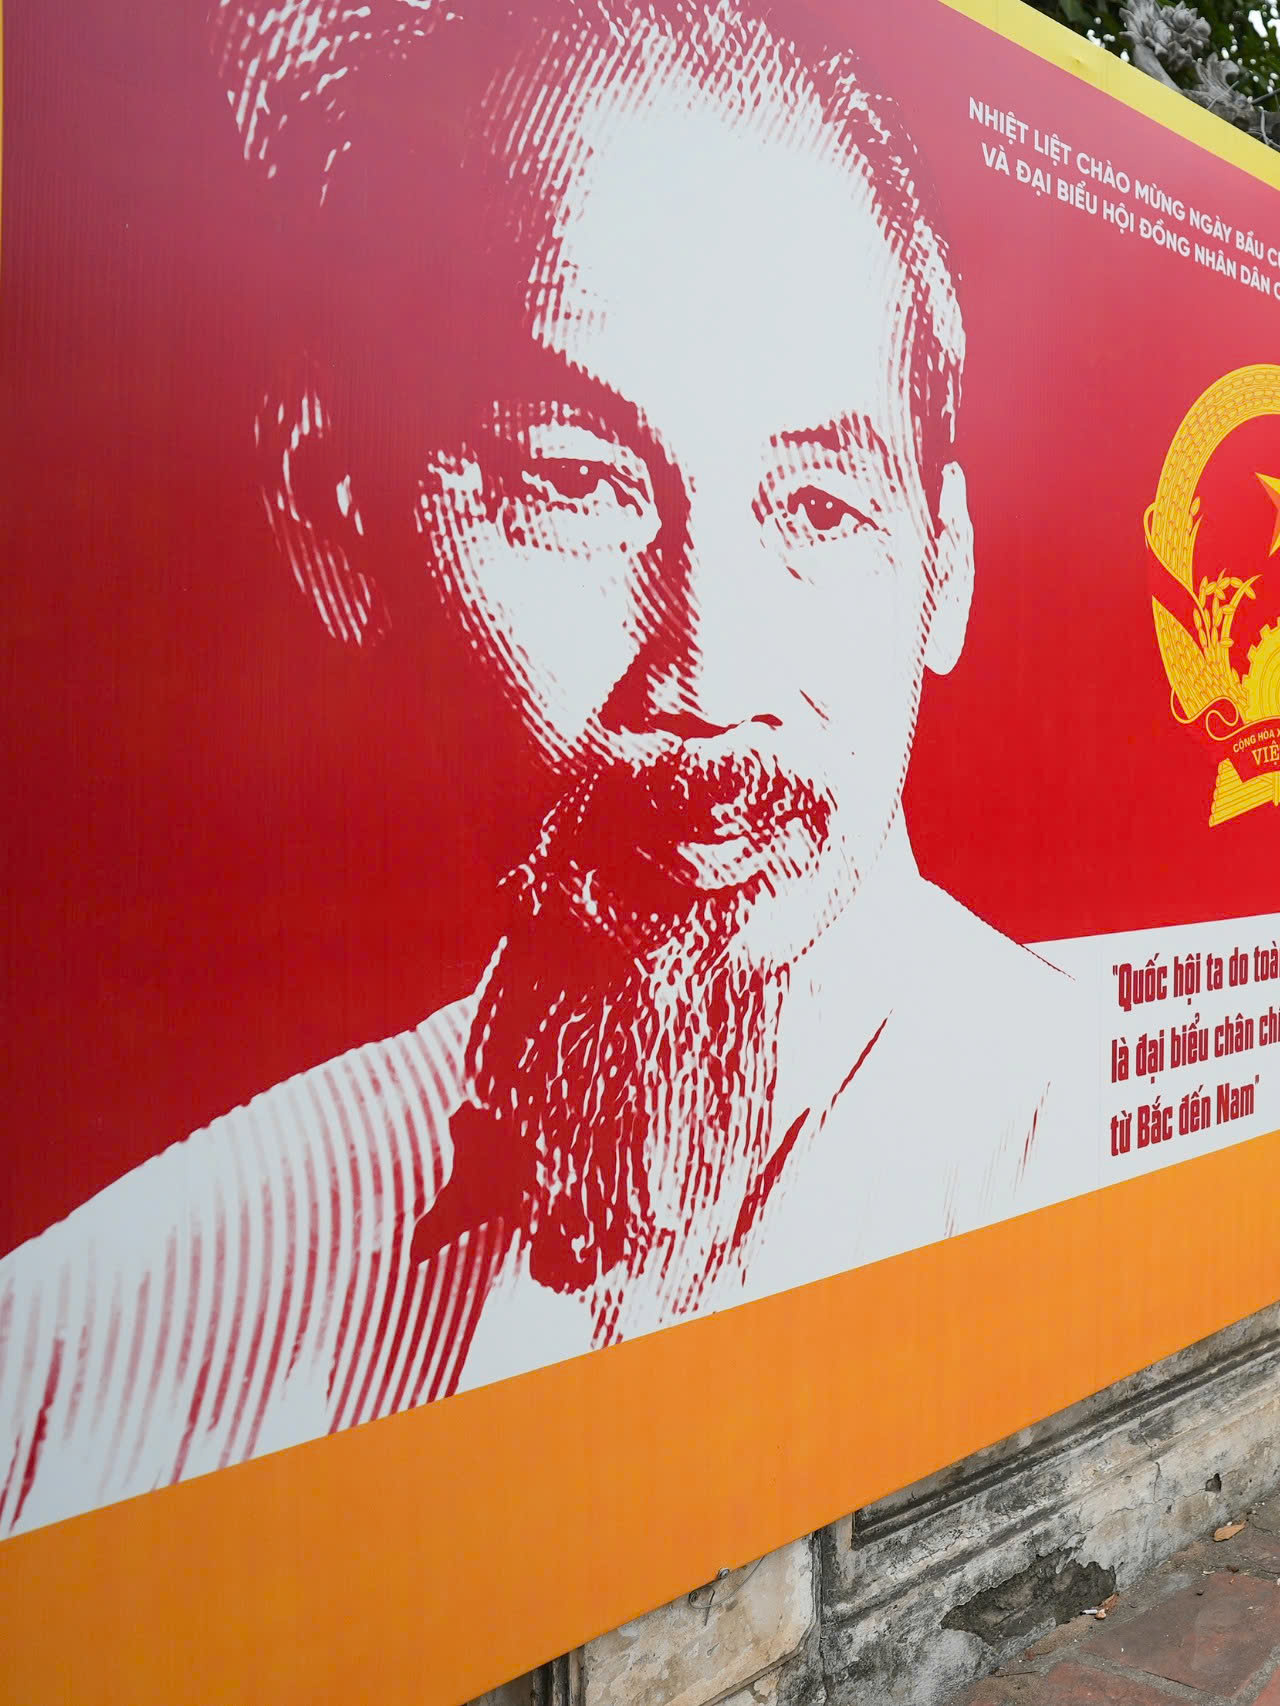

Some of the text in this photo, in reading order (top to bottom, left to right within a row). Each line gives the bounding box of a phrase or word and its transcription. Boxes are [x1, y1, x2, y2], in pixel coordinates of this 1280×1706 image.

[969, 96, 1029, 145] NHIỆT
[1034, 129, 1072, 167] LIỆT
[1076, 152, 1130, 194] CHÀO
[1135, 179, 1185, 221] MỪNG
[1190, 208, 1232, 244] NGÀY
[981, 142, 1010, 176] VÀ
[1016, 159, 1051, 196] ĐẠI
[1057, 178, 1098, 214] BIỂU
[1103, 200, 1135, 234] HỘI
[1139, 218, 1190, 257] ĐỒNG
[1194, 243, 1237, 280] NHÂN
[1240, 265, 1271, 295] DÂN
[1112, 953, 1168, 1012] "Quốc
[1173, 953, 1201, 1005] hội
[1206, 953, 1223, 992] ta
[1228, 947, 1249, 988] do
[1111, 1036, 1129, 1083] là
[1135, 1029, 1165, 1084] đại
[1170, 1012, 1209, 1069] biểu
[1214, 1012, 1254, 1058] chân
[1110, 1110, 1132, 1157] từ
[1137, 1096, 1174, 1149] Bắc
[1178, 1085, 1211, 1136] đến
